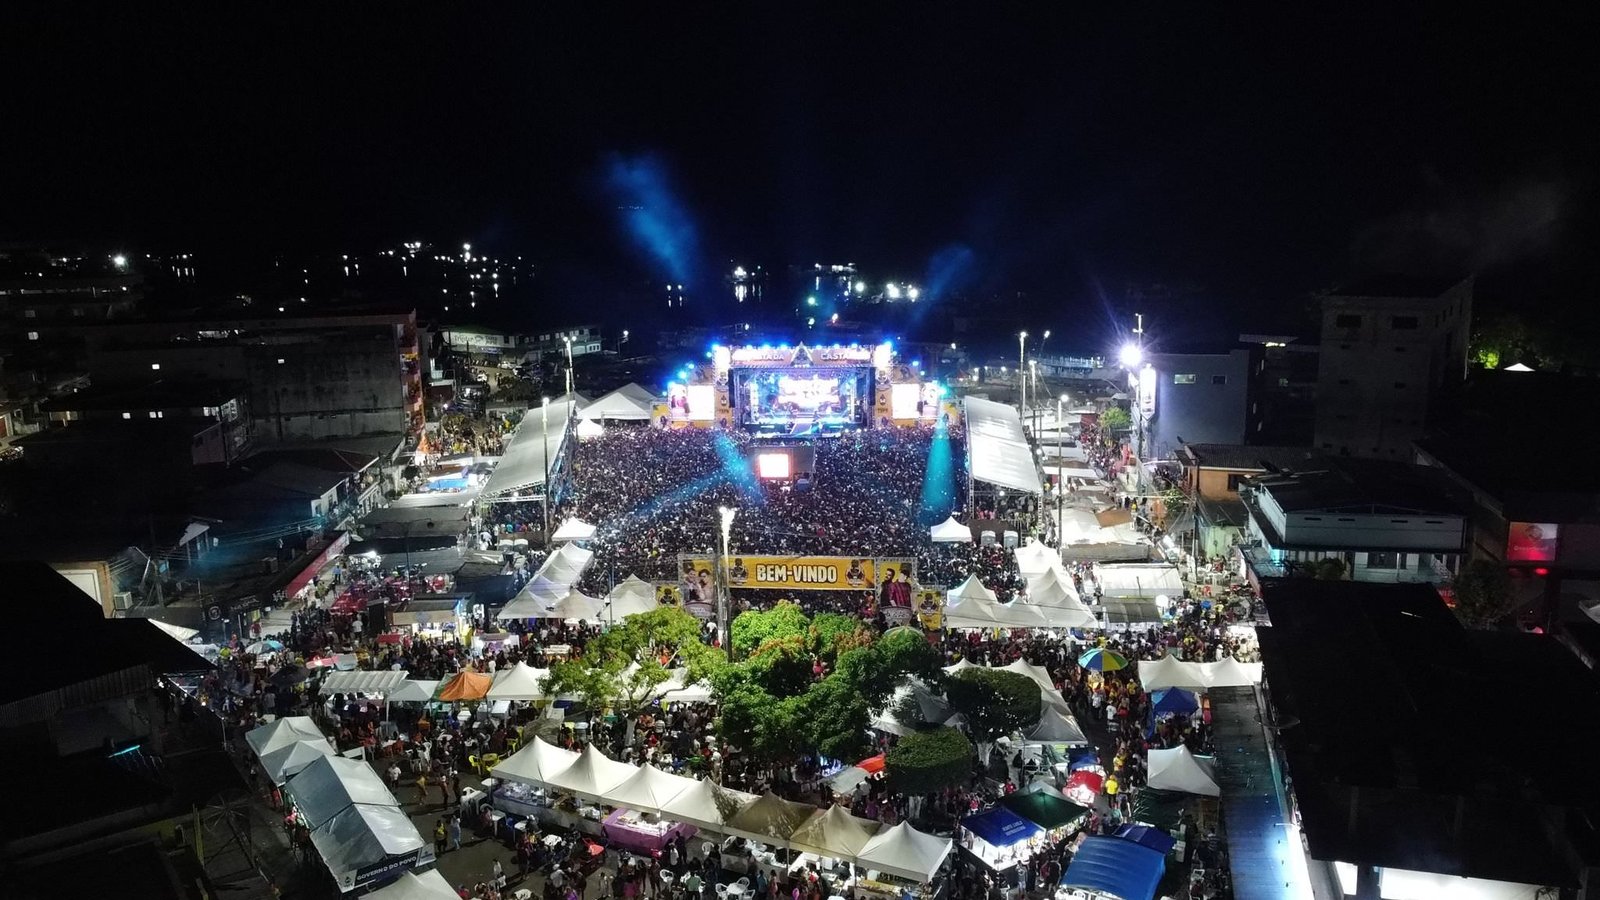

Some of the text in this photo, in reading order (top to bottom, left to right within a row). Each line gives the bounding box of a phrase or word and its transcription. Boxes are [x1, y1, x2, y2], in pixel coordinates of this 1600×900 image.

[756, 564, 837, 583] BEM-VINDO
[357, 866, 388, 880] GOVERNO
[389, 862, 399, 870] DO
[399, 856, 417, 866] POVO
